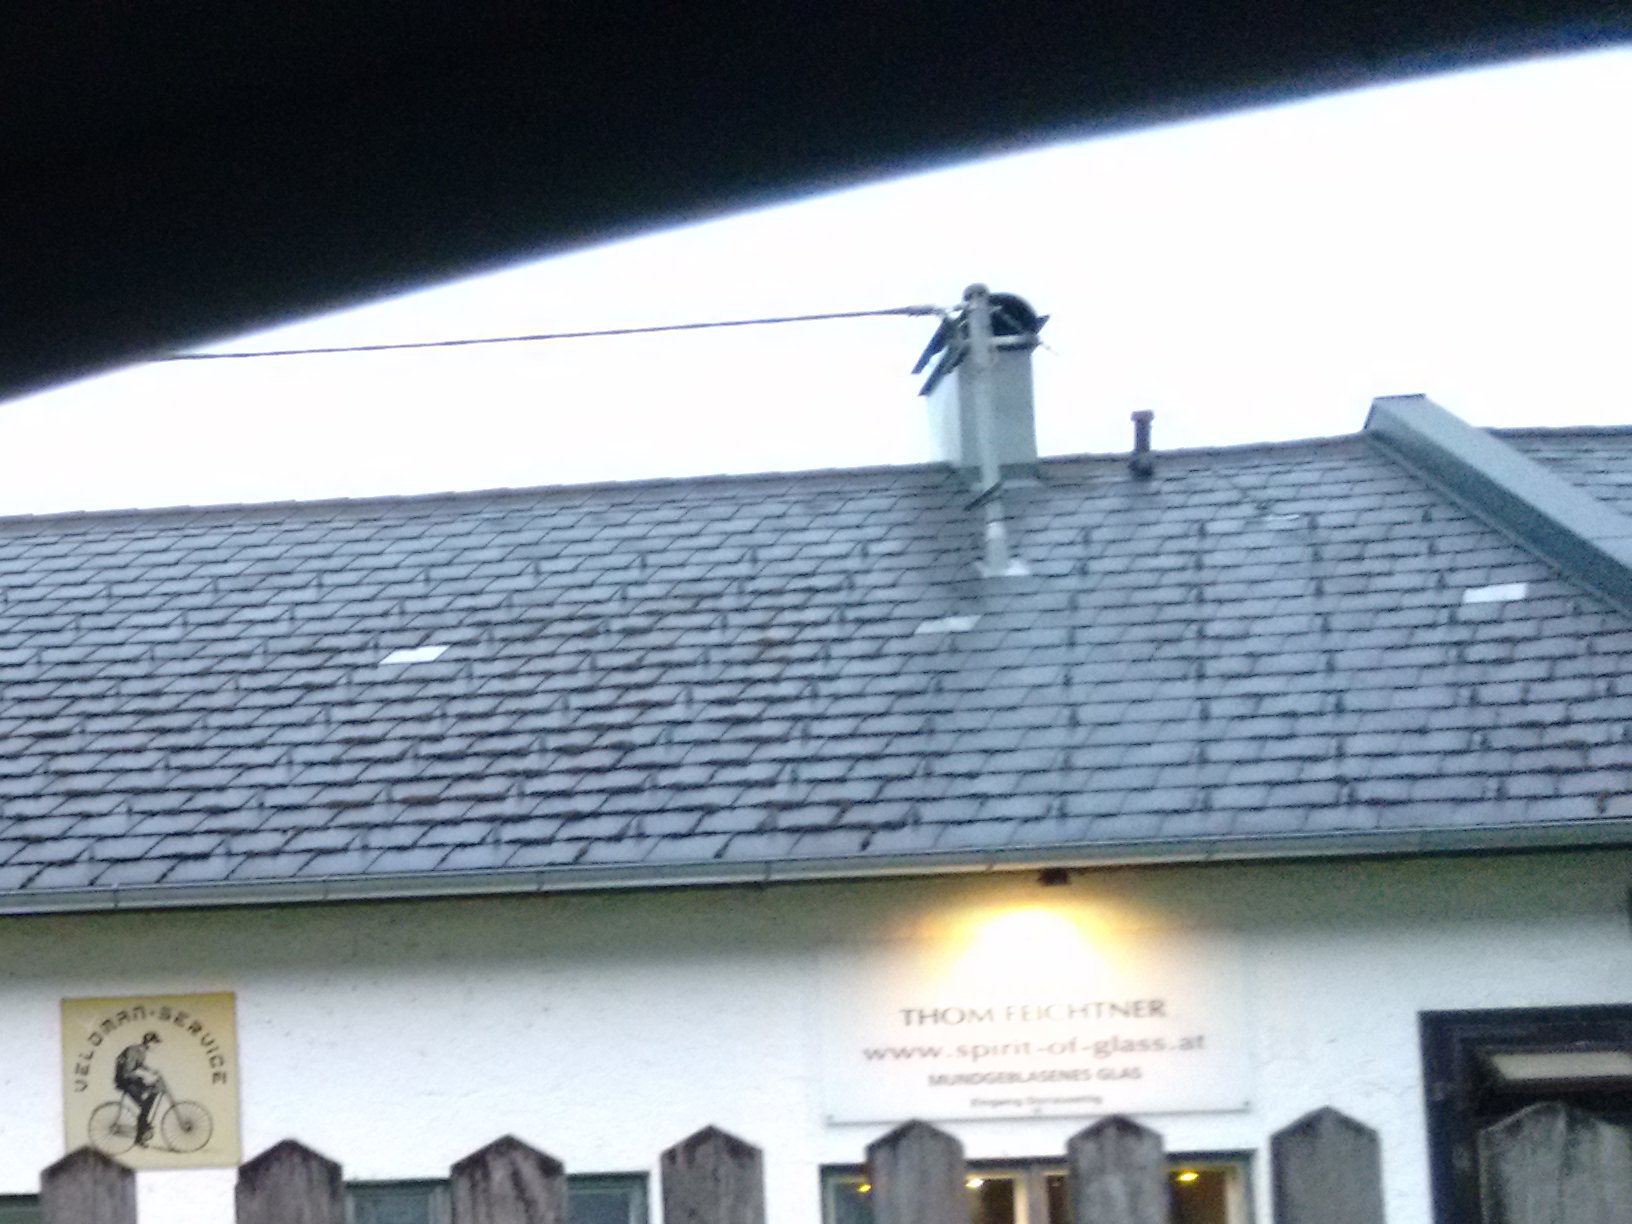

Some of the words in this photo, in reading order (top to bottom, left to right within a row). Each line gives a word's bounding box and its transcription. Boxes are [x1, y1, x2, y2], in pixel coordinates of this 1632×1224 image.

[898, 1007, 994, 1028] THOM
[1005, 998, 1169, 1024] FEICHTNER
[158, 1006, 227, 1085] SERVICE
[863, 1032, 1205, 1063] www.spirit-of-glass.at
[928, 1067, 1092, 1087] MUNDGEBLASENES
[1095, 1066, 1143, 1082] GLAS
